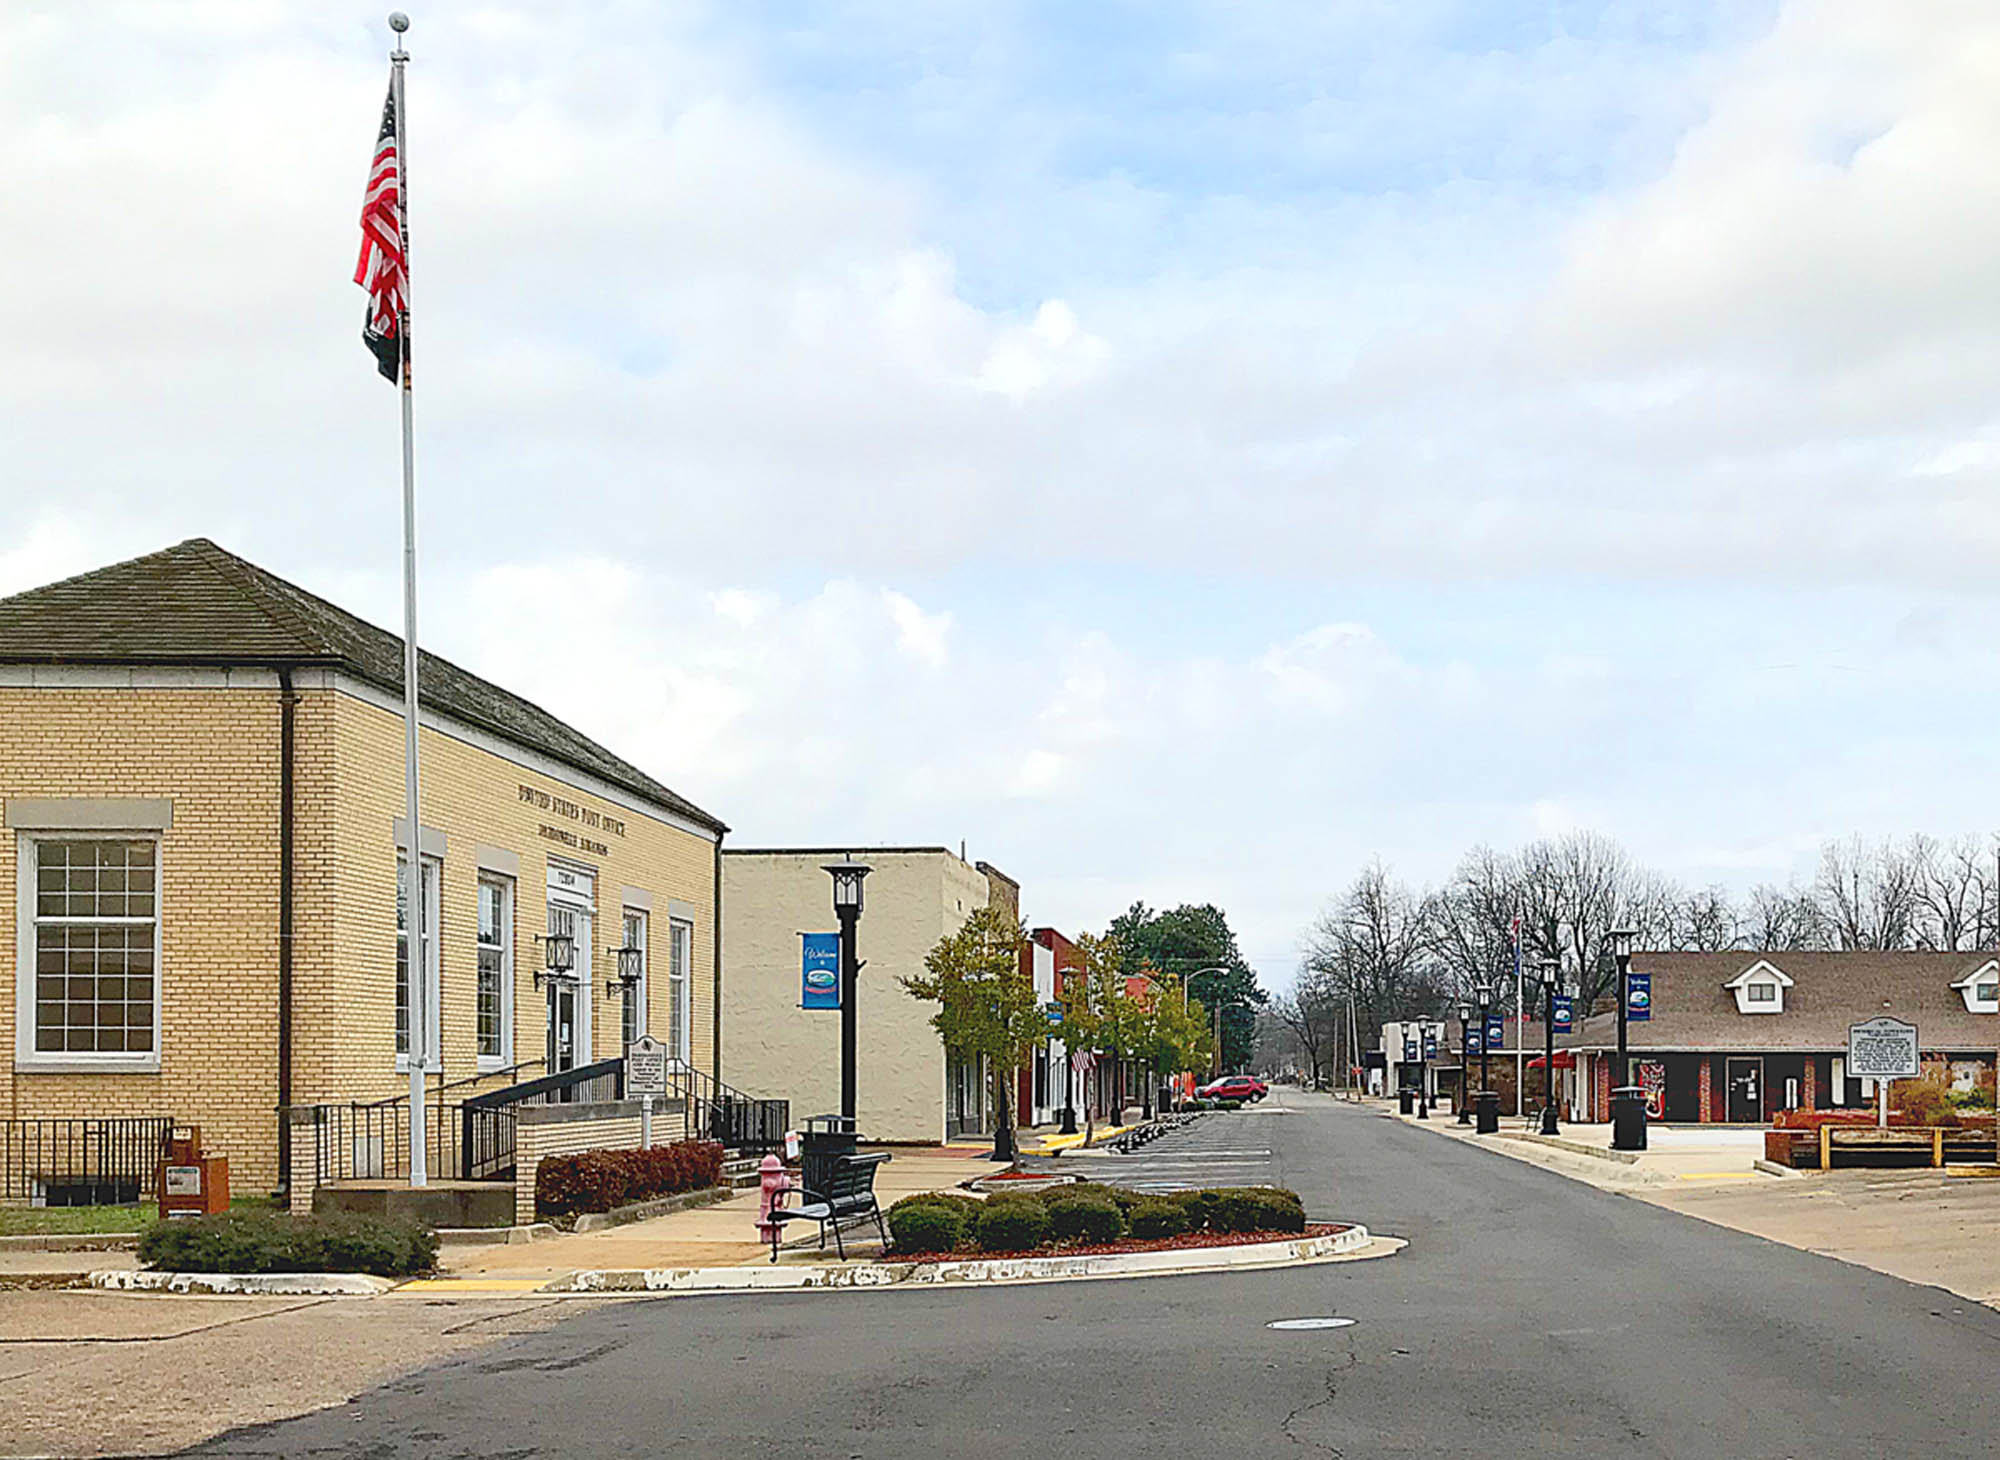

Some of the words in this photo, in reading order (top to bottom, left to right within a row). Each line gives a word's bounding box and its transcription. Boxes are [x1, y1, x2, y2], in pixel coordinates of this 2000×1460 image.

[553, 797, 579, 820] STATES
[581, 807, 600, 828] POST
[602, 815, 625, 837] OFFICE
